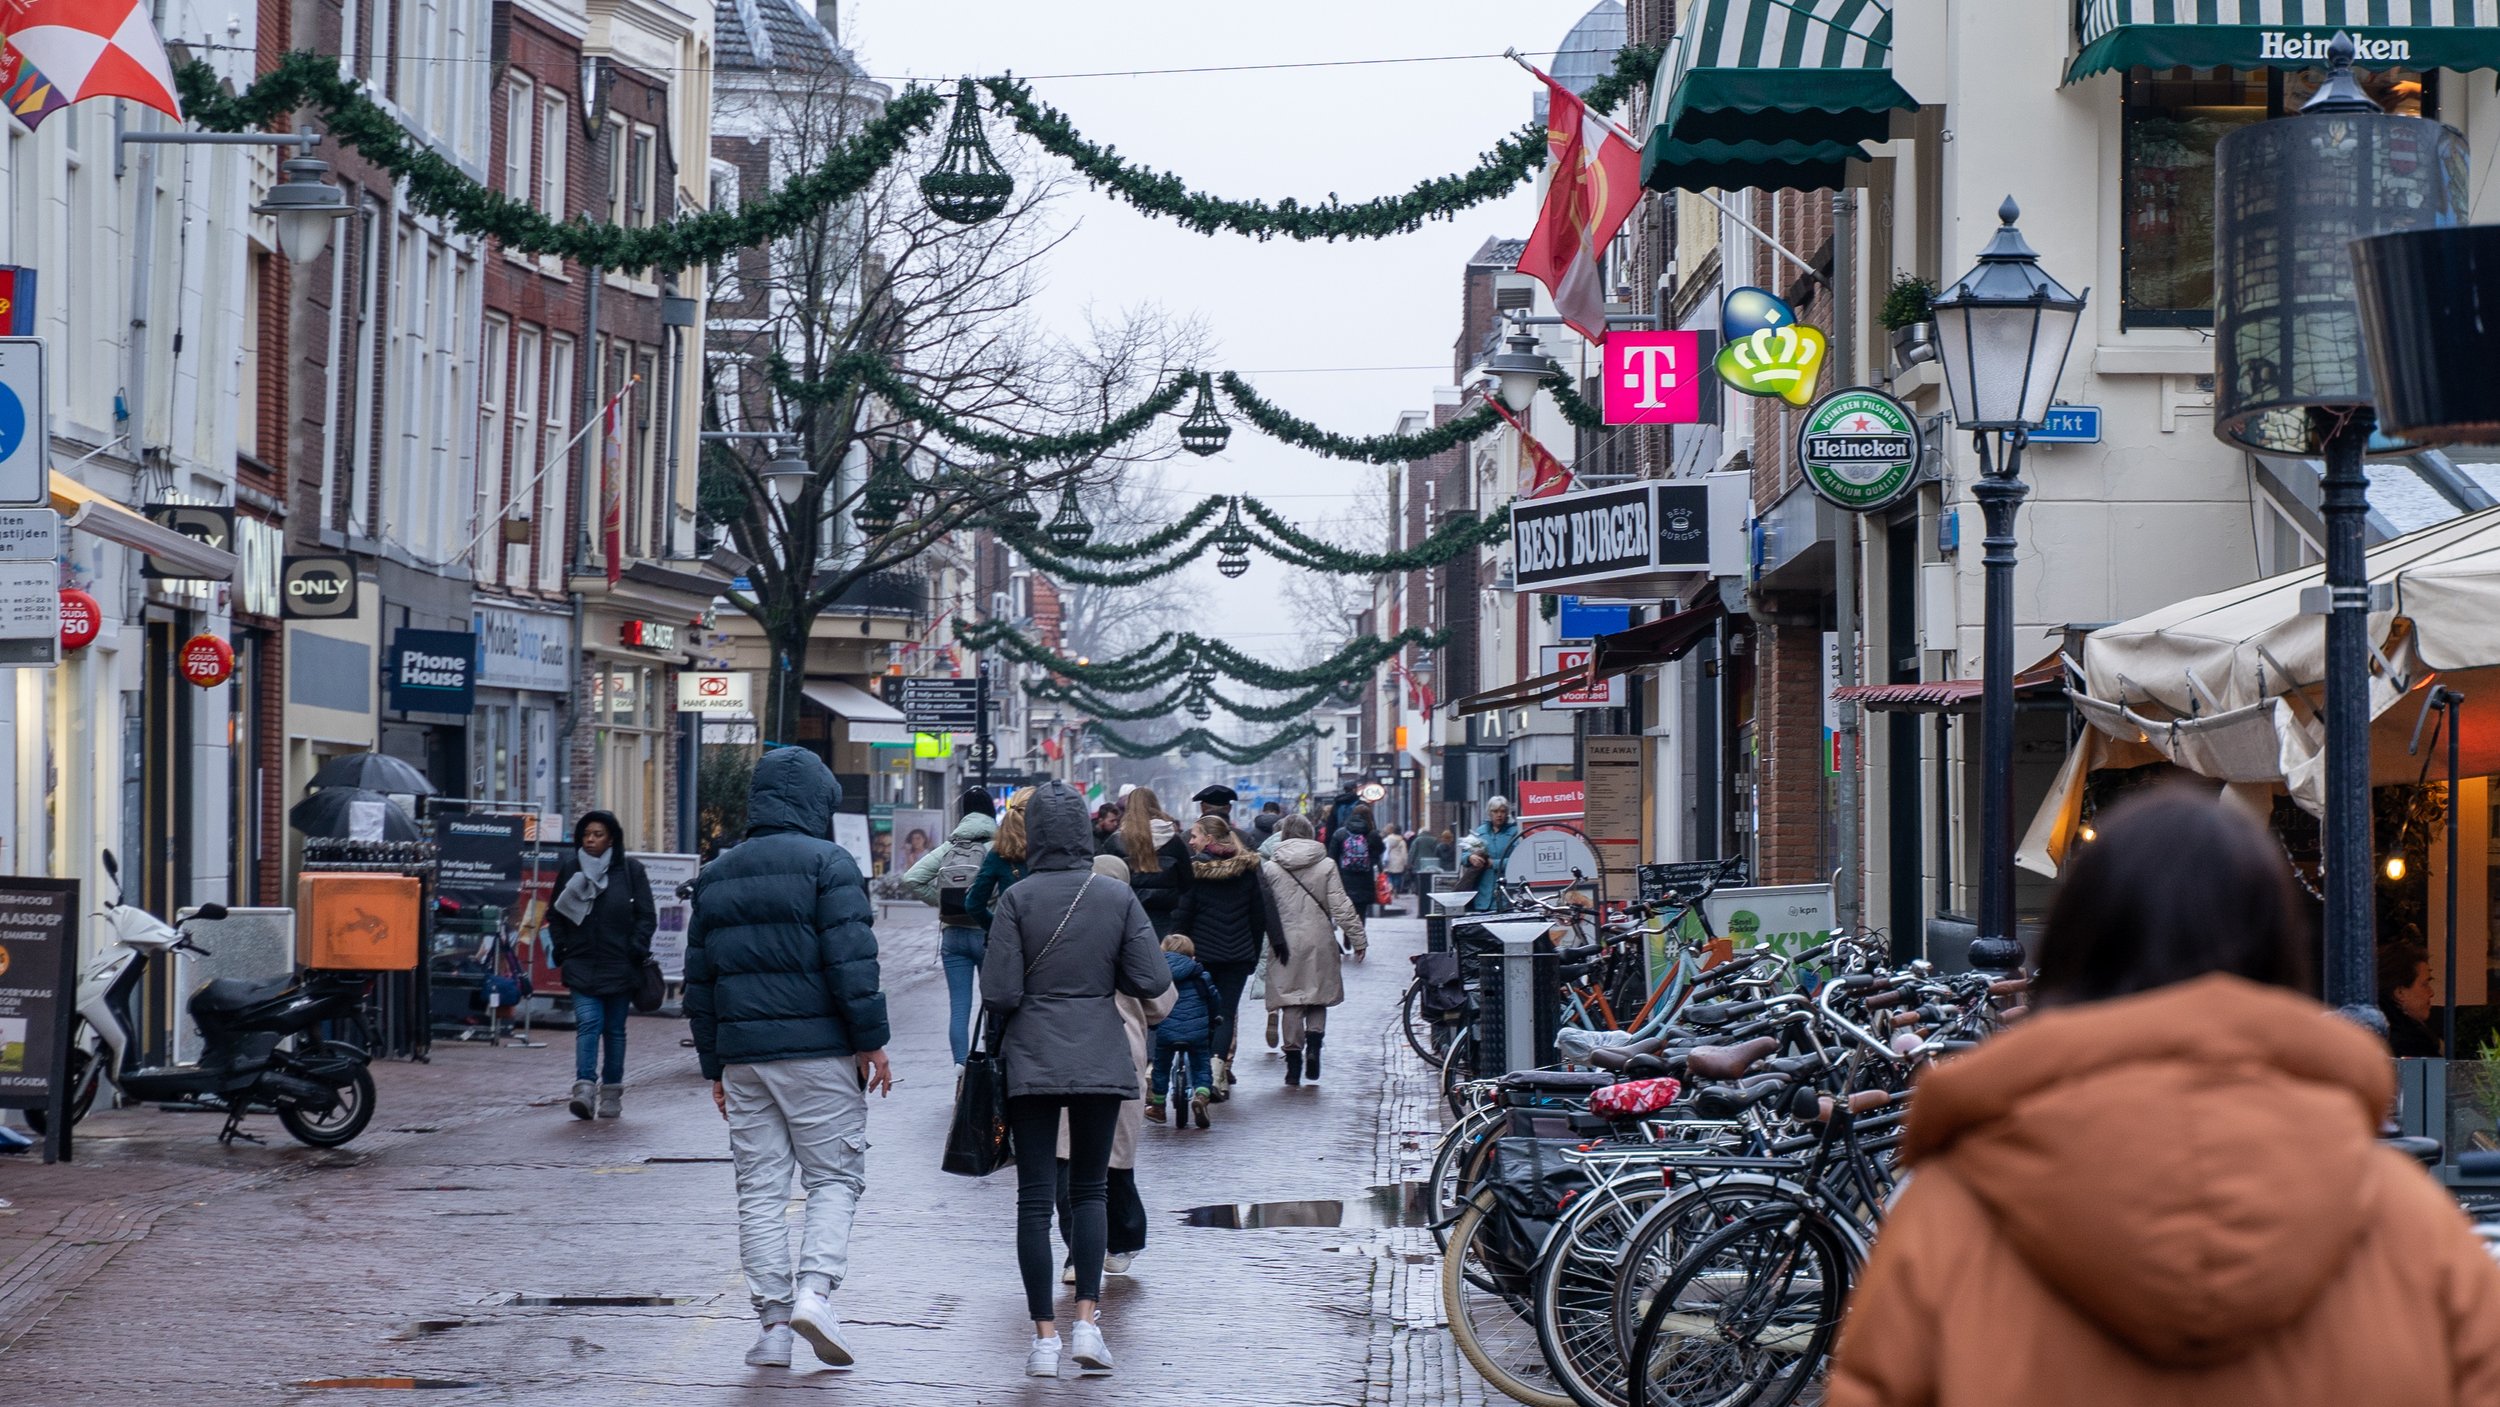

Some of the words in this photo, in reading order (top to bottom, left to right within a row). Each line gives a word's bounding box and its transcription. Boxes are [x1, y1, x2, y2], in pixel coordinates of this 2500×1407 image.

[2260, 32, 2411, 60] Heinken
[1820, 400, 1860, 426] HEINEKEN
[1862, 401, 1900, 426] PILSENER
[2044, 415, 2083, 431] arkt
[1813, 440, 1908, 457] Heineken
[1820, 471, 1862, 497] PREMIUM
[1865, 470, 1901, 497] QUALITY
[1666, 508, 1694, 518] BEST
[0, 529, 48, 541] stijden
[1518, 514, 1567, 573] BEST
[1570, 502, 1649, 566] BURGER
[1660, 529, 1702, 541] BURGER
[288, 579, 349, 596] ONLY
[61, 610, 89, 618] OUDA
[486, 609, 518, 656] Mobile
[541, 634, 563, 667] Gouda
[402, 651, 466, 671] Phone
[188, 662, 219, 675] 750
[401, 668, 464, 687] House
[710, 700, 744, 708] ANDERS
[1590, 746, 1610, 754] TAKE
[1612, 746, 1637, 754] AWAY
[1529, 794, 1552, 804] Kom
[1554, 792, 1576, 802] snel
[1577, 791, 1585, 801] b
[1538, 852, 1563, 862] DELI
[1799, 906, 1818, 915] kpn
[13, 1076, 48, 1088] GOUDA
